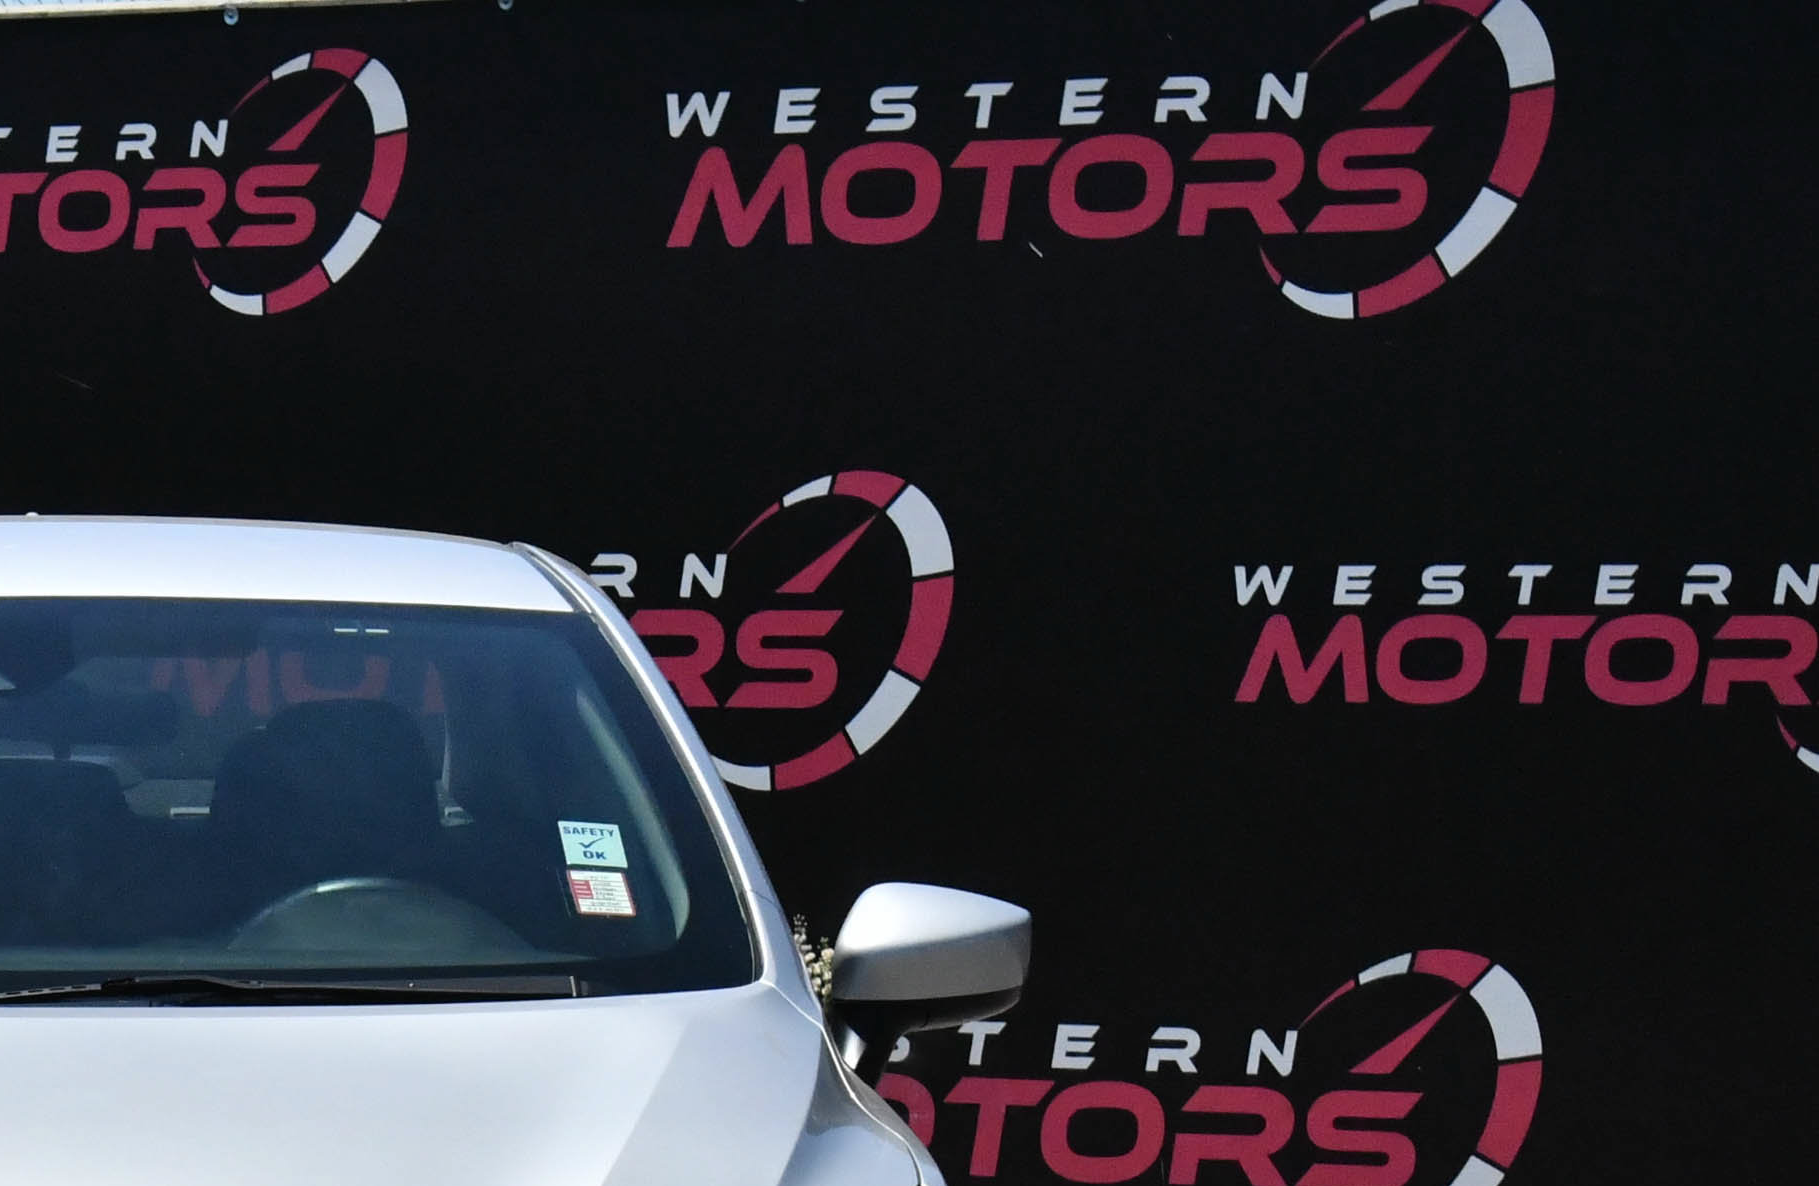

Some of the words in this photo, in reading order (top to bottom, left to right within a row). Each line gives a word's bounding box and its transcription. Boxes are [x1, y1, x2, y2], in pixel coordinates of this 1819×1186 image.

[666, 71, 1309, 139] WESTERN
[667, 125, 1435, 249] MOTORS
[1234, 563, 1819, 607] WESTERN
[1235, 612, 1819, 707] MOTOR
[562, 826, 615, 837] SAFETY
[582, 850, 607, 860] OK
[888, 1020, 1299, 1077] TERN
